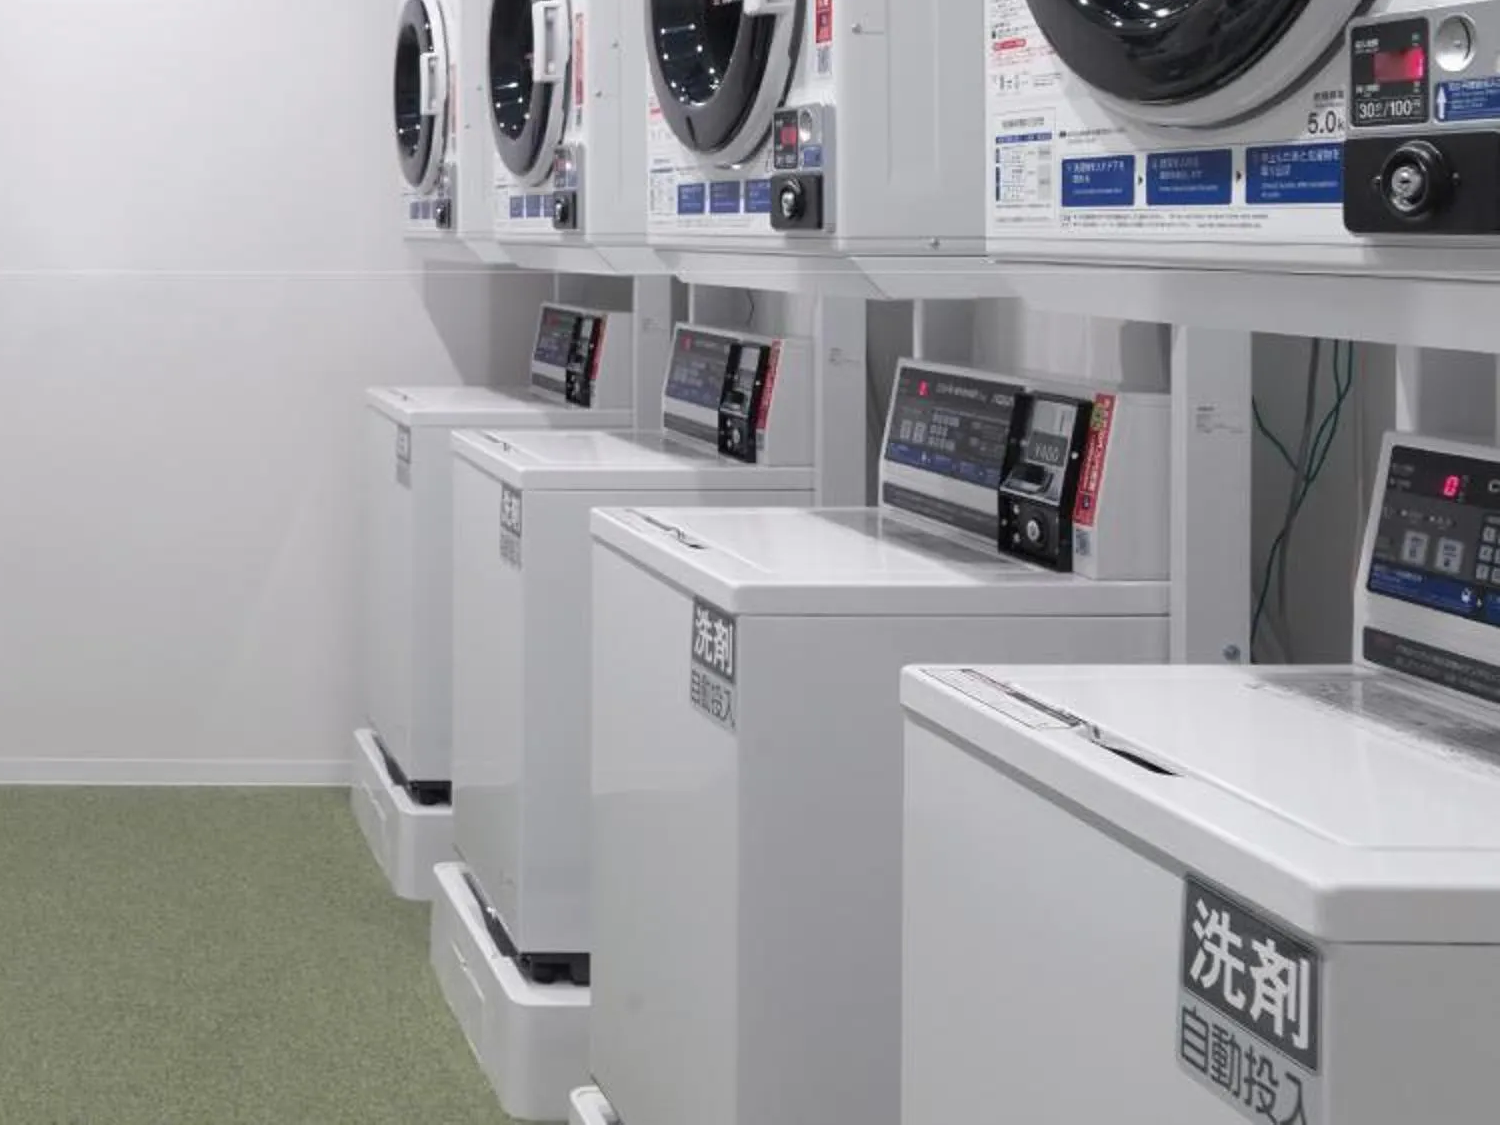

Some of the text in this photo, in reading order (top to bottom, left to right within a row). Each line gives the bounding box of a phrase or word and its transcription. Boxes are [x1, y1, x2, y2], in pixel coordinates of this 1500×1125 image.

[1307, 110, 1346, 135] 5.0k
[694, 606, 733, 675] 洗剤
[1189, 897, 1311, 1050] 洗剤
[1180, 1005, 1309, 1125] 自動投入
